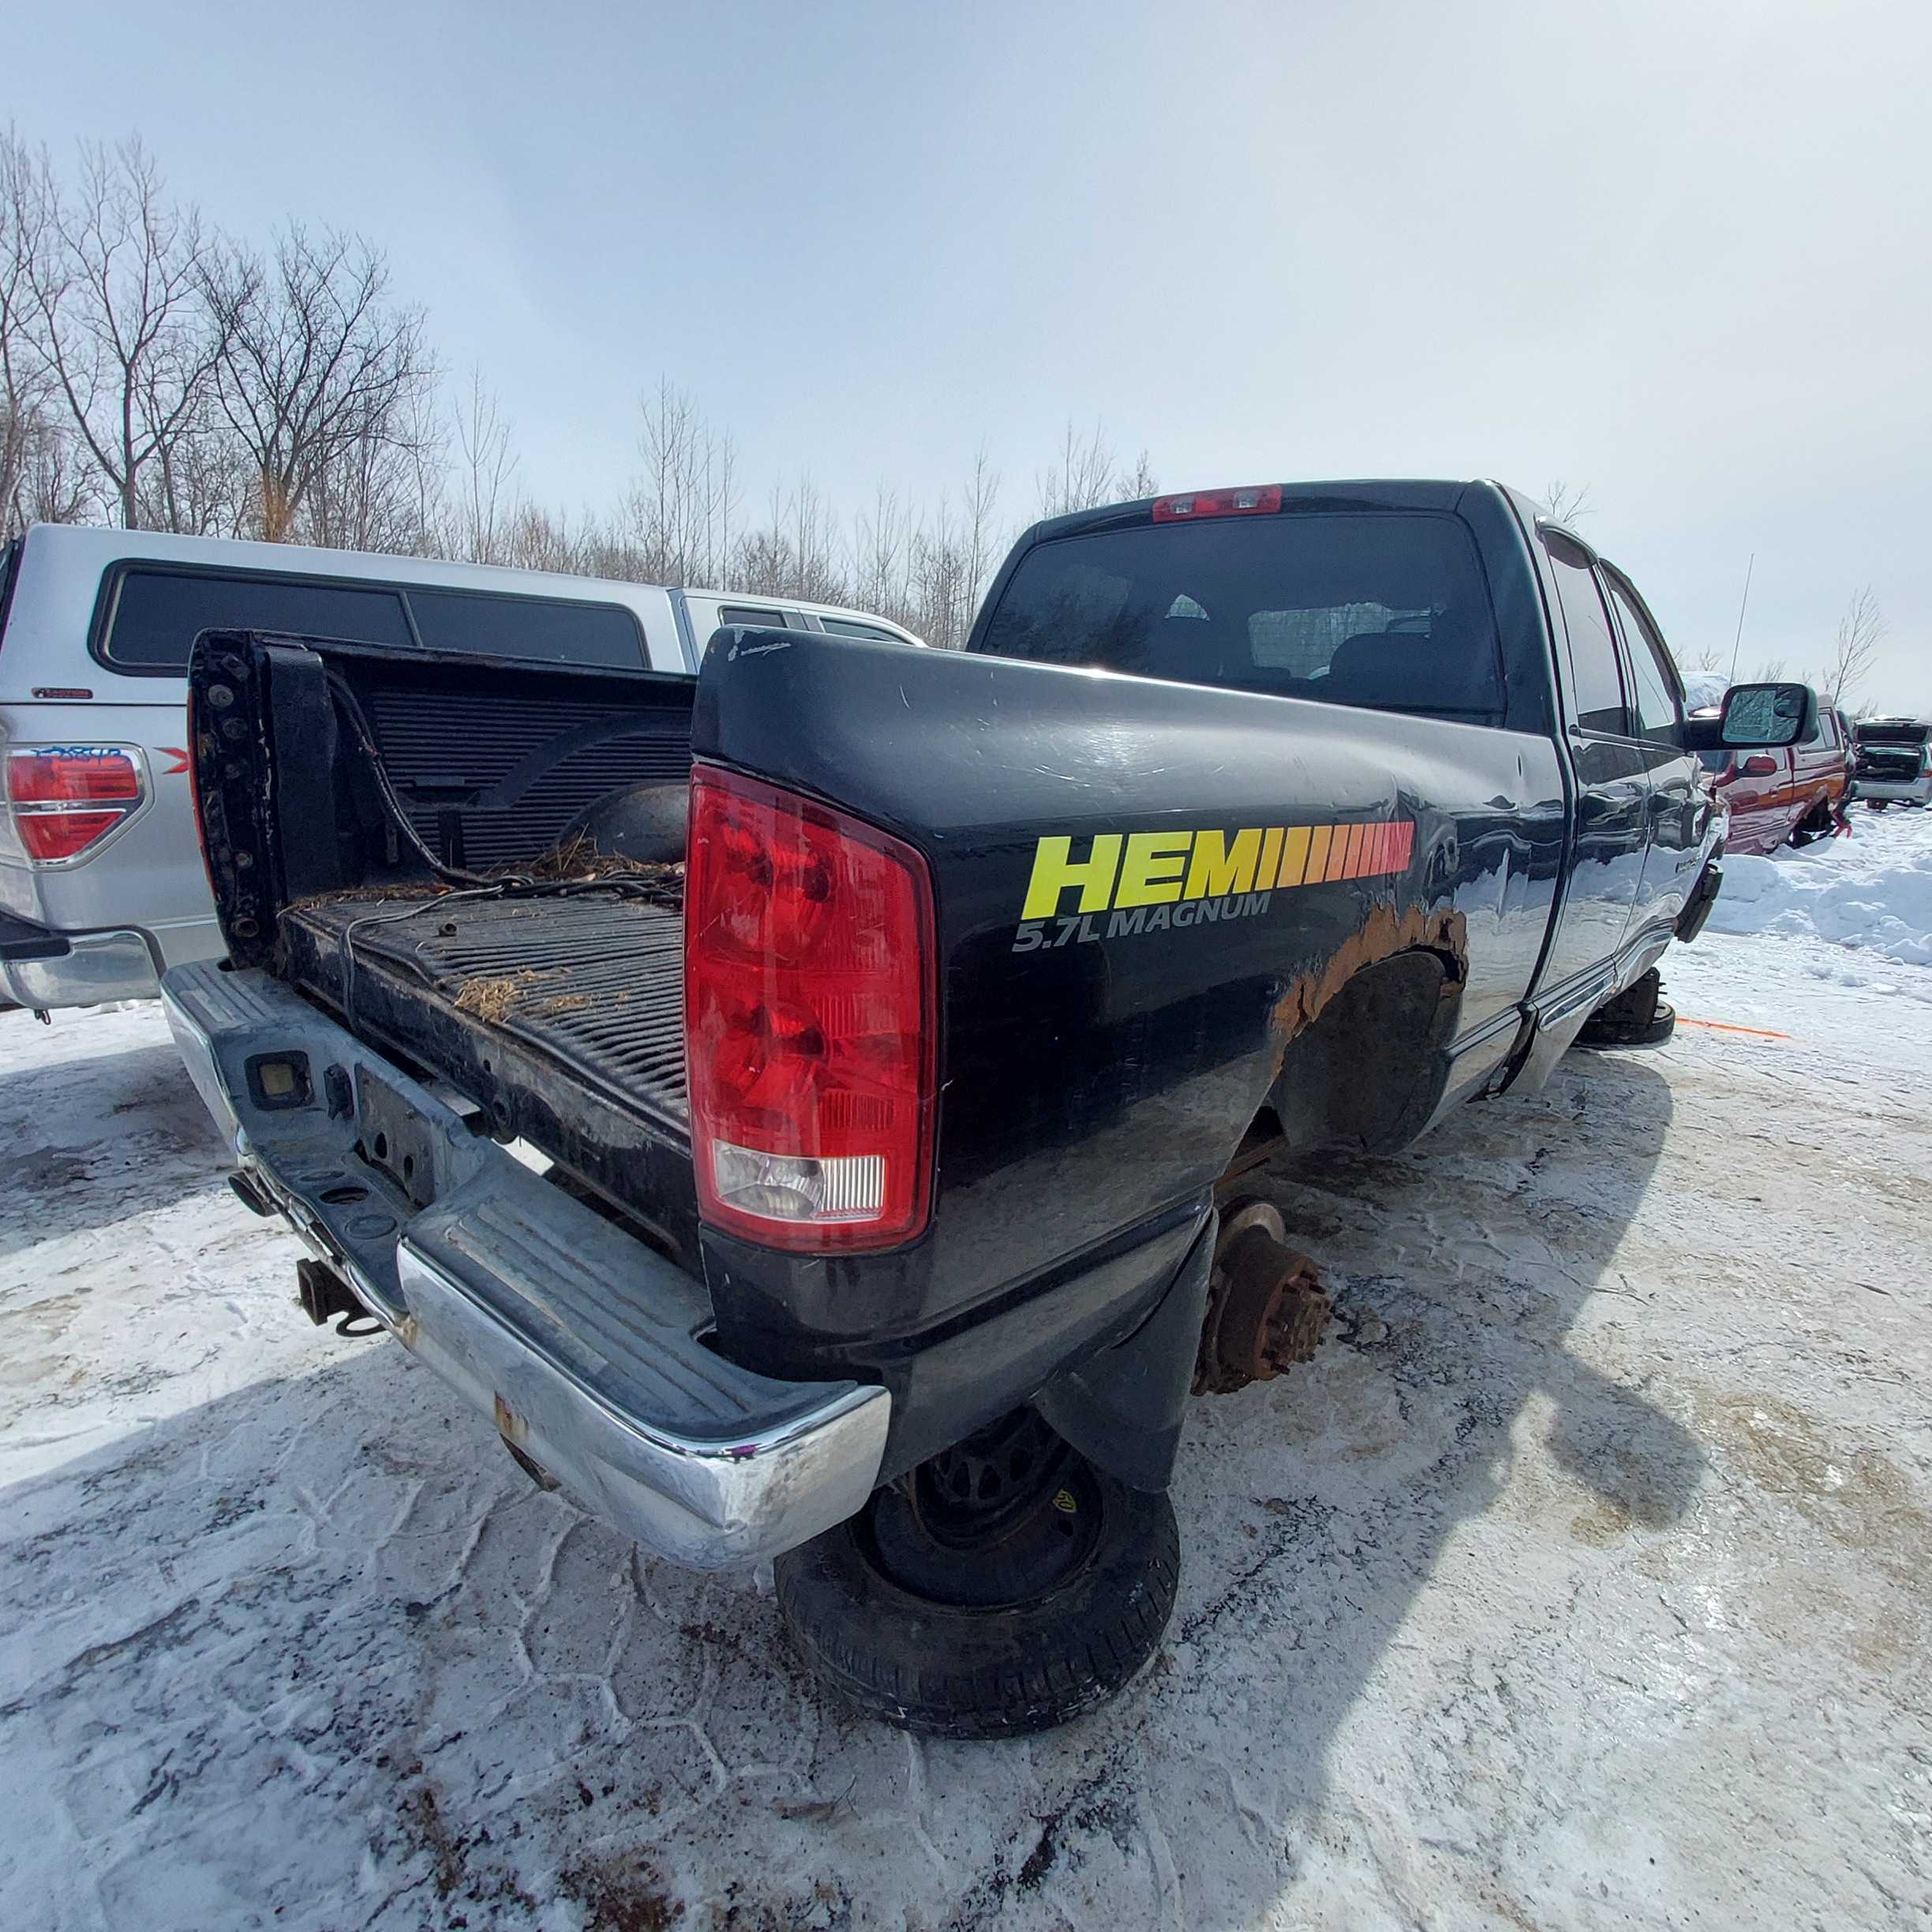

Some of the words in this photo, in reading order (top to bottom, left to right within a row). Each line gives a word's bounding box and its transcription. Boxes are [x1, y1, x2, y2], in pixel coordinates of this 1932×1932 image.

[1021, 826, 1285, 921] HEMI
[1012, 915, 1101, 953] 5.7L
[1106, 891, 1272, 939] MAGNUM
